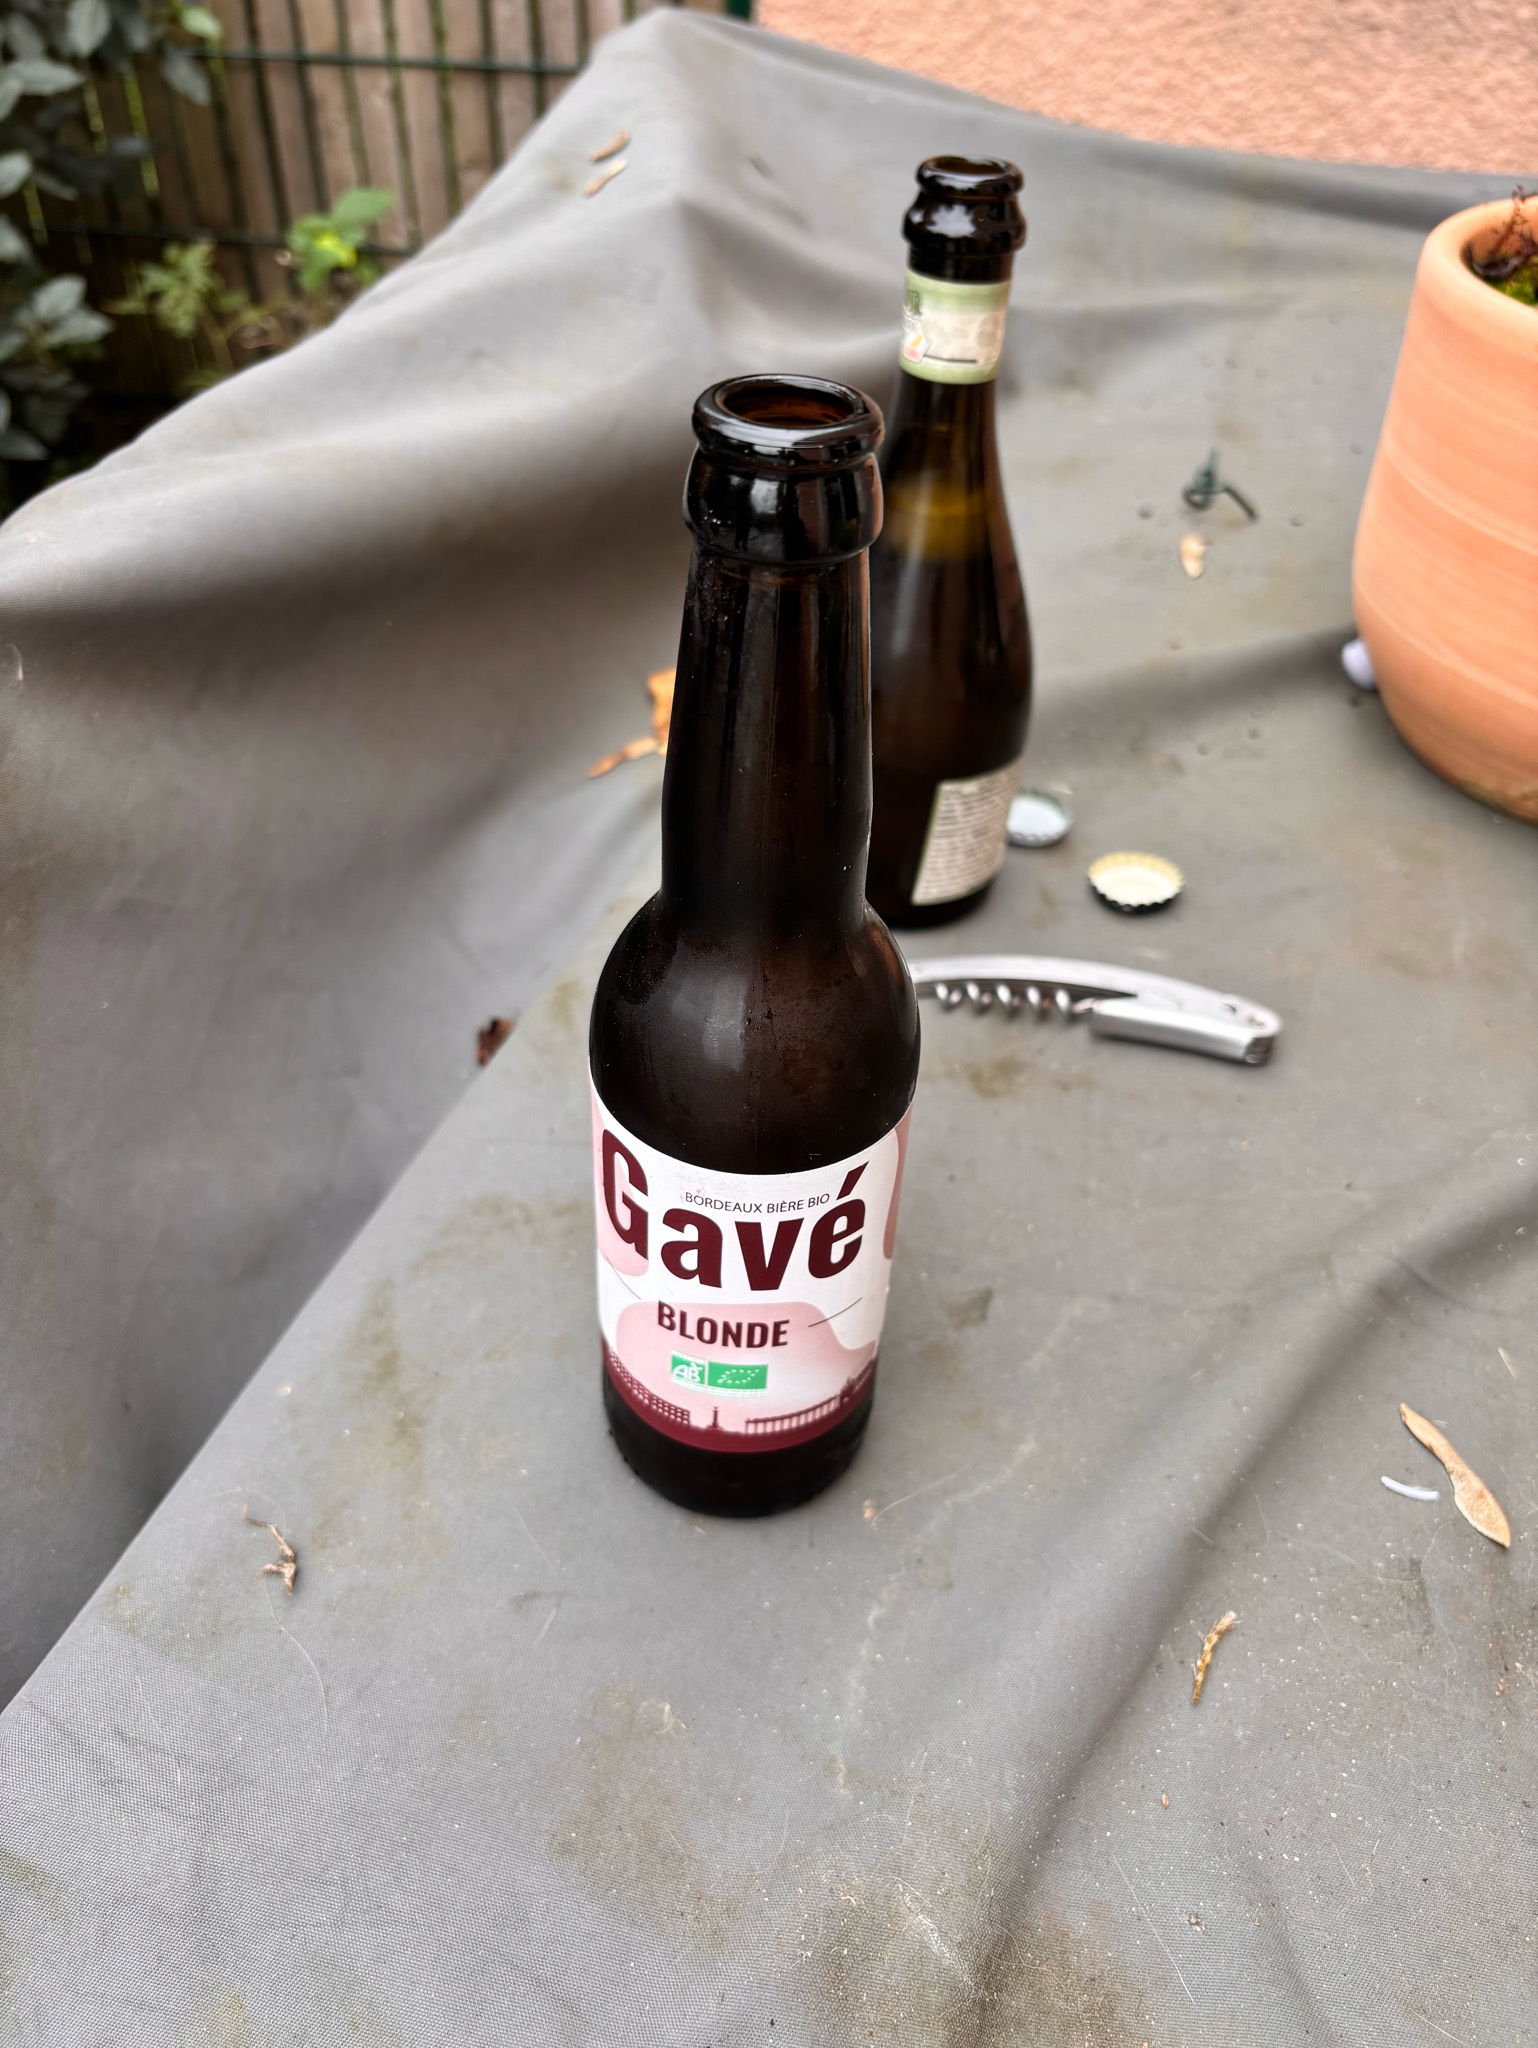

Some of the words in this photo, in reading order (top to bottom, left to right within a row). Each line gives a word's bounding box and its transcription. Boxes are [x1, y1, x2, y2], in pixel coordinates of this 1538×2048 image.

[602, 1128, 870, 1291] Gavé
[685, 1191, 763, 1213] BORDEAUX
[766, 1200, 804, 1214] BIÈRE
[808, 1193, 830, 1208] BIO
[657, 1300, 790, 1349] BLONDE
[672, 1363, 702, 1382] AB
